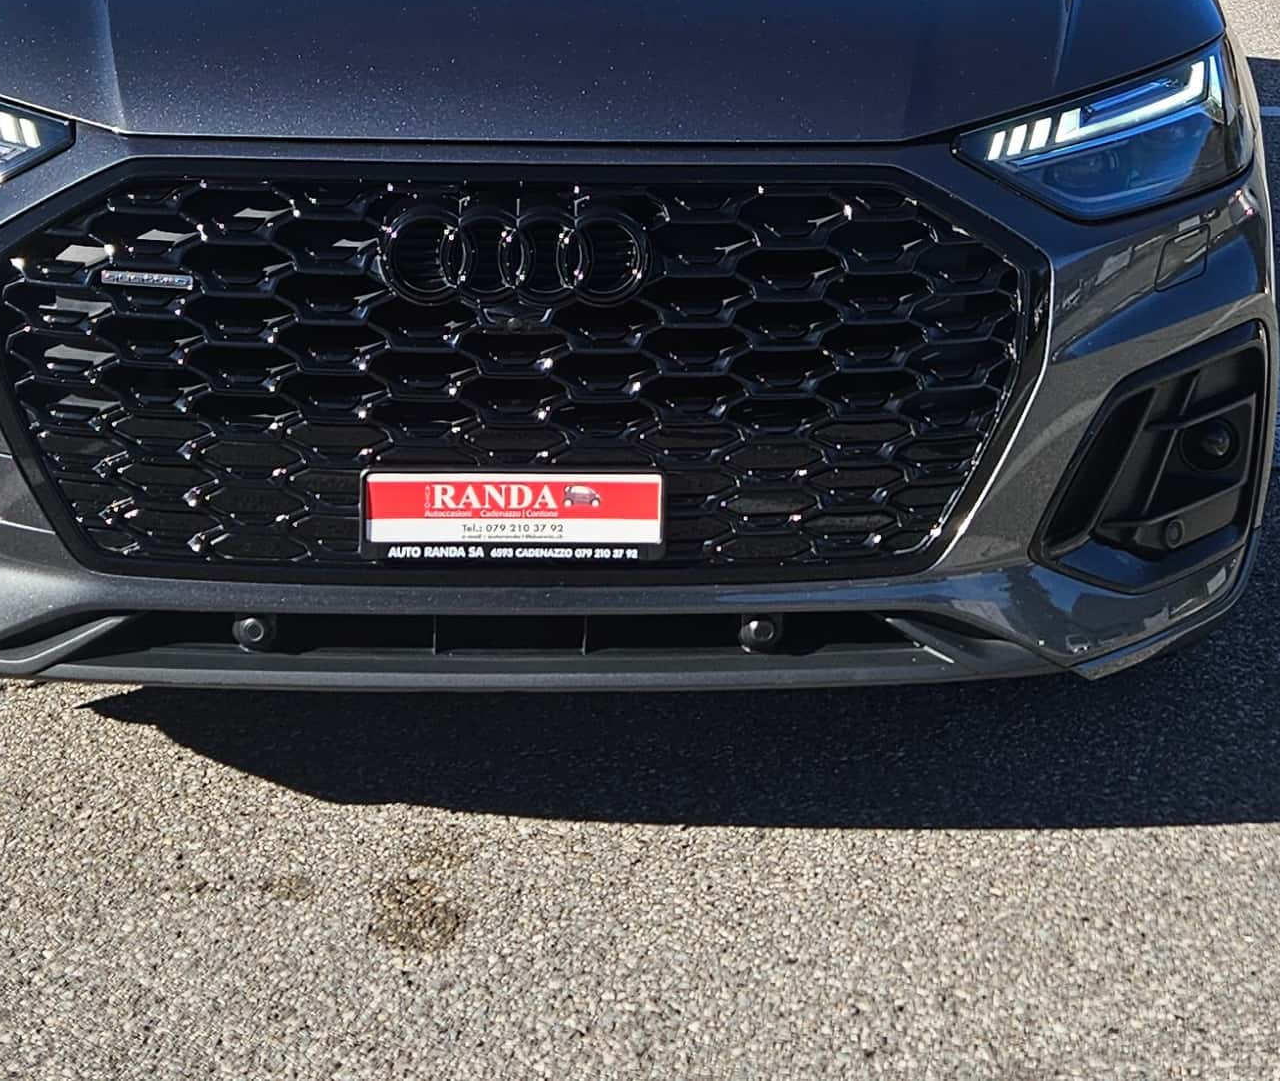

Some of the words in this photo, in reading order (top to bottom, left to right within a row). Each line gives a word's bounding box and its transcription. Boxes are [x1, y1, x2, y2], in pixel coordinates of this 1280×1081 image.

[431, 484, 559, 509] RANDA
[486, 524, 506, 532] 079
[510, 524, 530, 532] 210
[533, 524, 547, 532] 37
[550, 524, 564, 532] 92
[388, 546, 421, 558] AUTO
[424, 546, 466, 558] RANDA
[468, 546, 484, 558] SA
[490, 548, 514, 558] 6593
[515, 548, 573, 558] CADENAZZO
[574, 548, 593, 558] 079
[594, 548, 611, 559] 210
[612, 548, 625, 559] 37
[625, 548, 638, 559] 92
